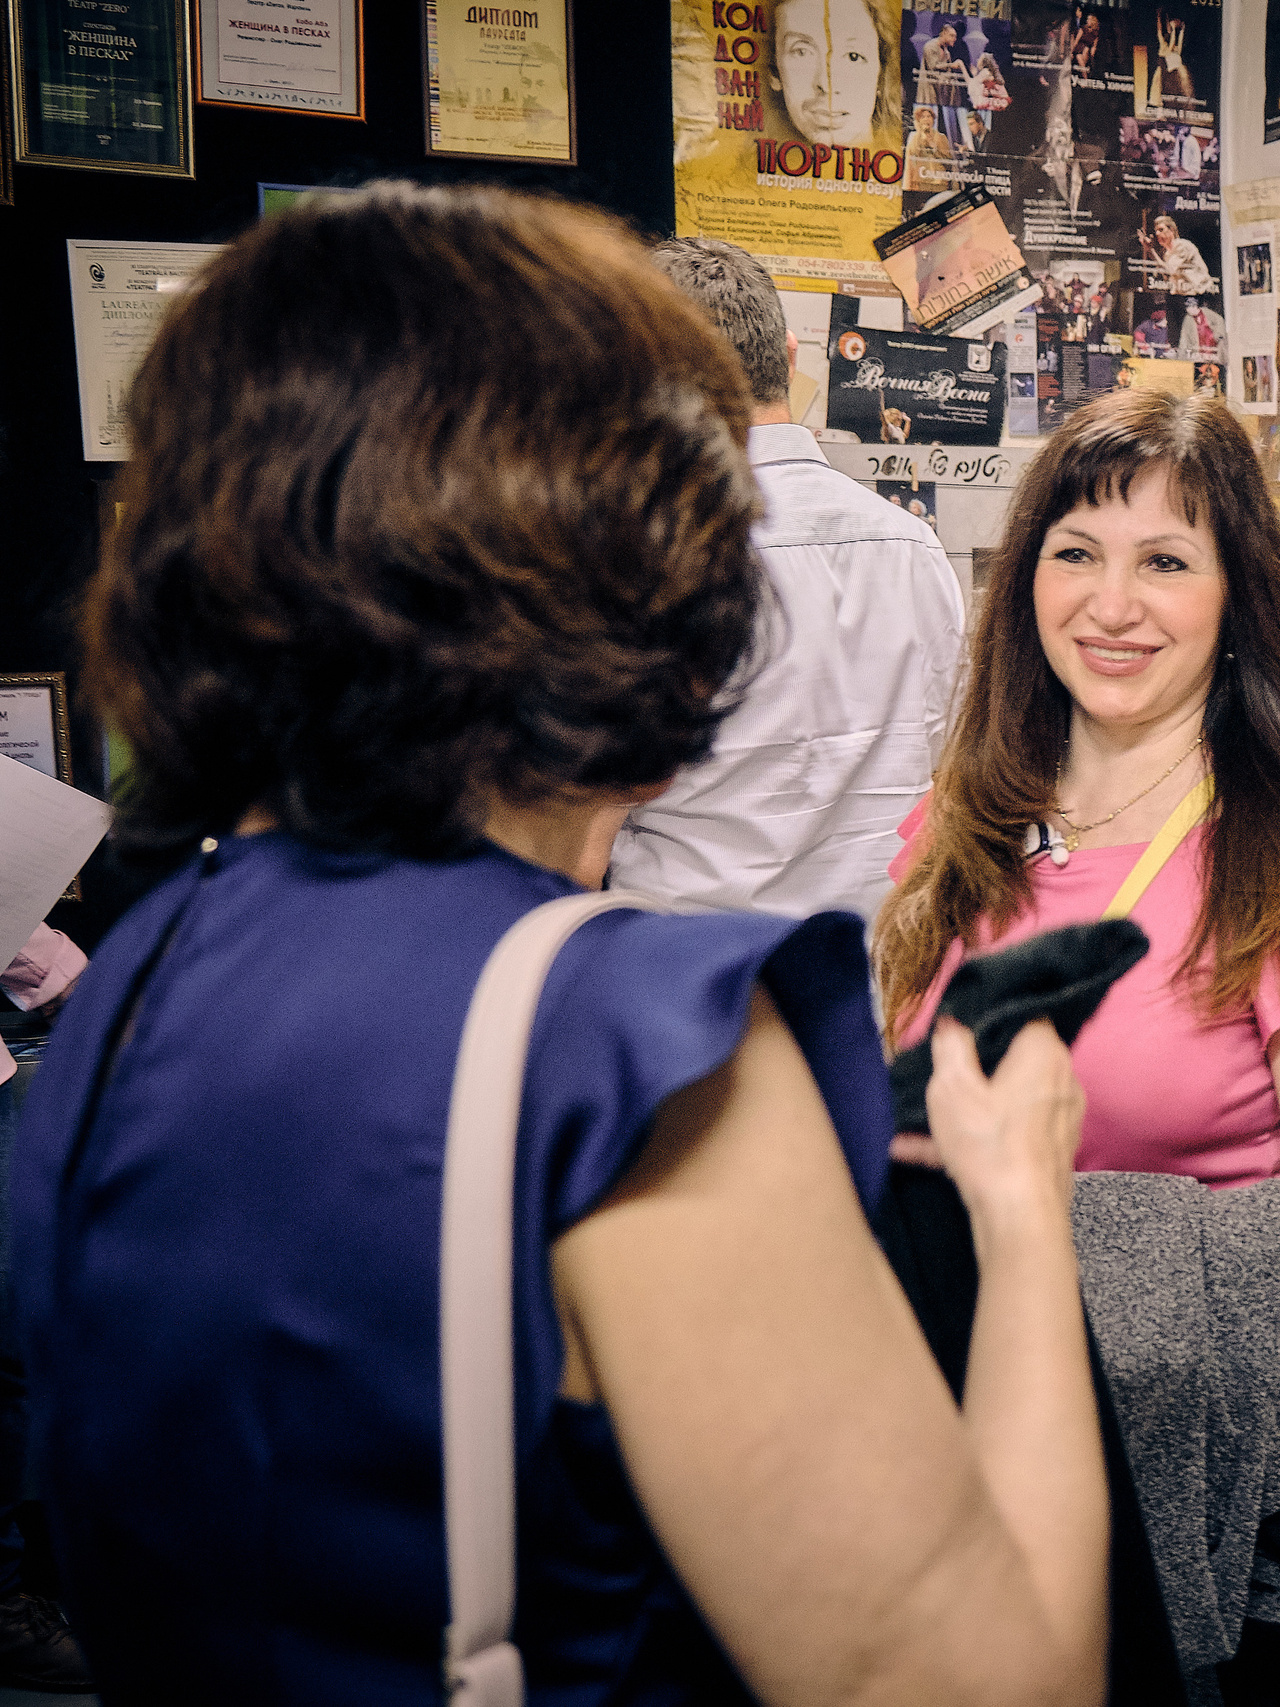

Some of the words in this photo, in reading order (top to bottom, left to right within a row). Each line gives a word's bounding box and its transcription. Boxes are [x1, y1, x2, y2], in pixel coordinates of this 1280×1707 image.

[464, 6, 539, 29] ДИПЛОМ
[713, 0, 767, 32] КОЛ
[228, 20, 281, 33] ЖЕНЩИНА
[283, 26, 290, 34] В
[292, 26, 331, 39] ПЕСКАХ
[479, 27, 527, 42] ЛАУРЕАТА
[68, 45, 77, 55] В
[714, 34, 760, 64] ДО
[715, 67, 761, 98] ВАН
[717, 100, 764, 132] НЫЙ
[757, 173, 813, 190] история
[816, 177, 864, 194] одного
[697, 192, 756, 206] Постановка
[974, 254, 1018, 287] אישה
[915, 281, 974, 321] בחולות
